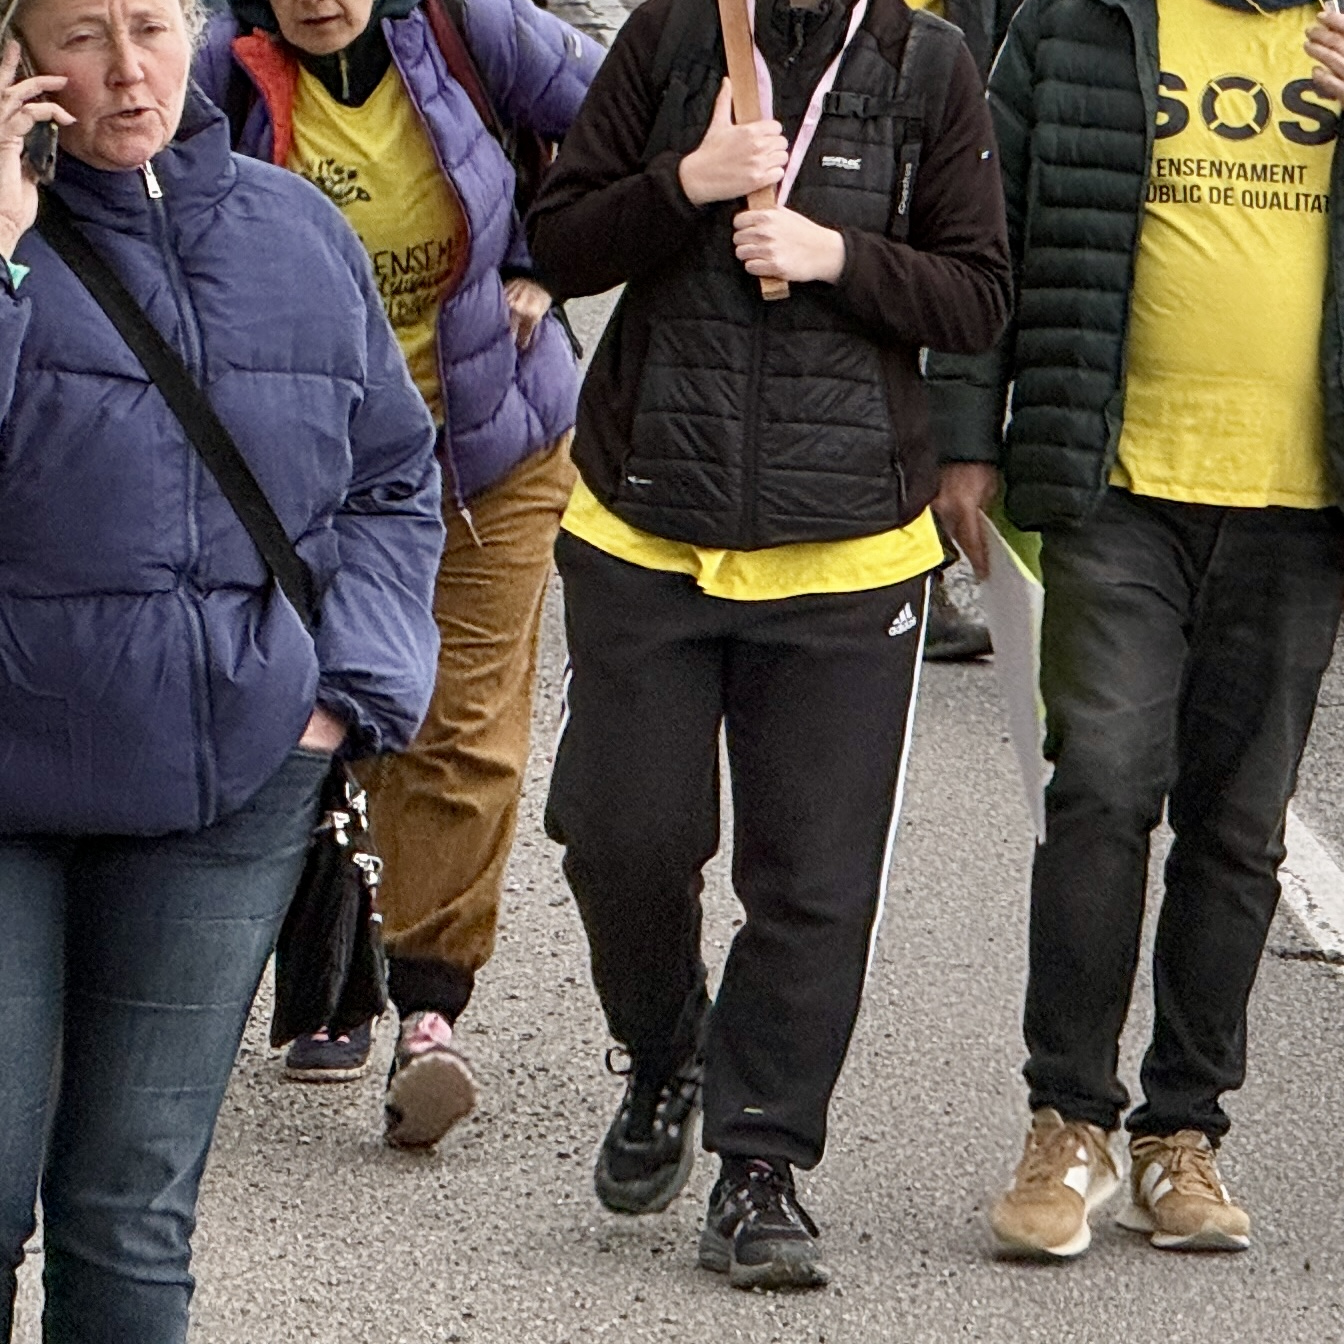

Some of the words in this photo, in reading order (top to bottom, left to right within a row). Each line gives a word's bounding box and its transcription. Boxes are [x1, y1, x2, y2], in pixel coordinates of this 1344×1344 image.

[1154, 71, 1339, 146] SOS
[1156, 158, 1308, 185] ENSENYAMENT
[1209, 186, 1234, 206] DE
